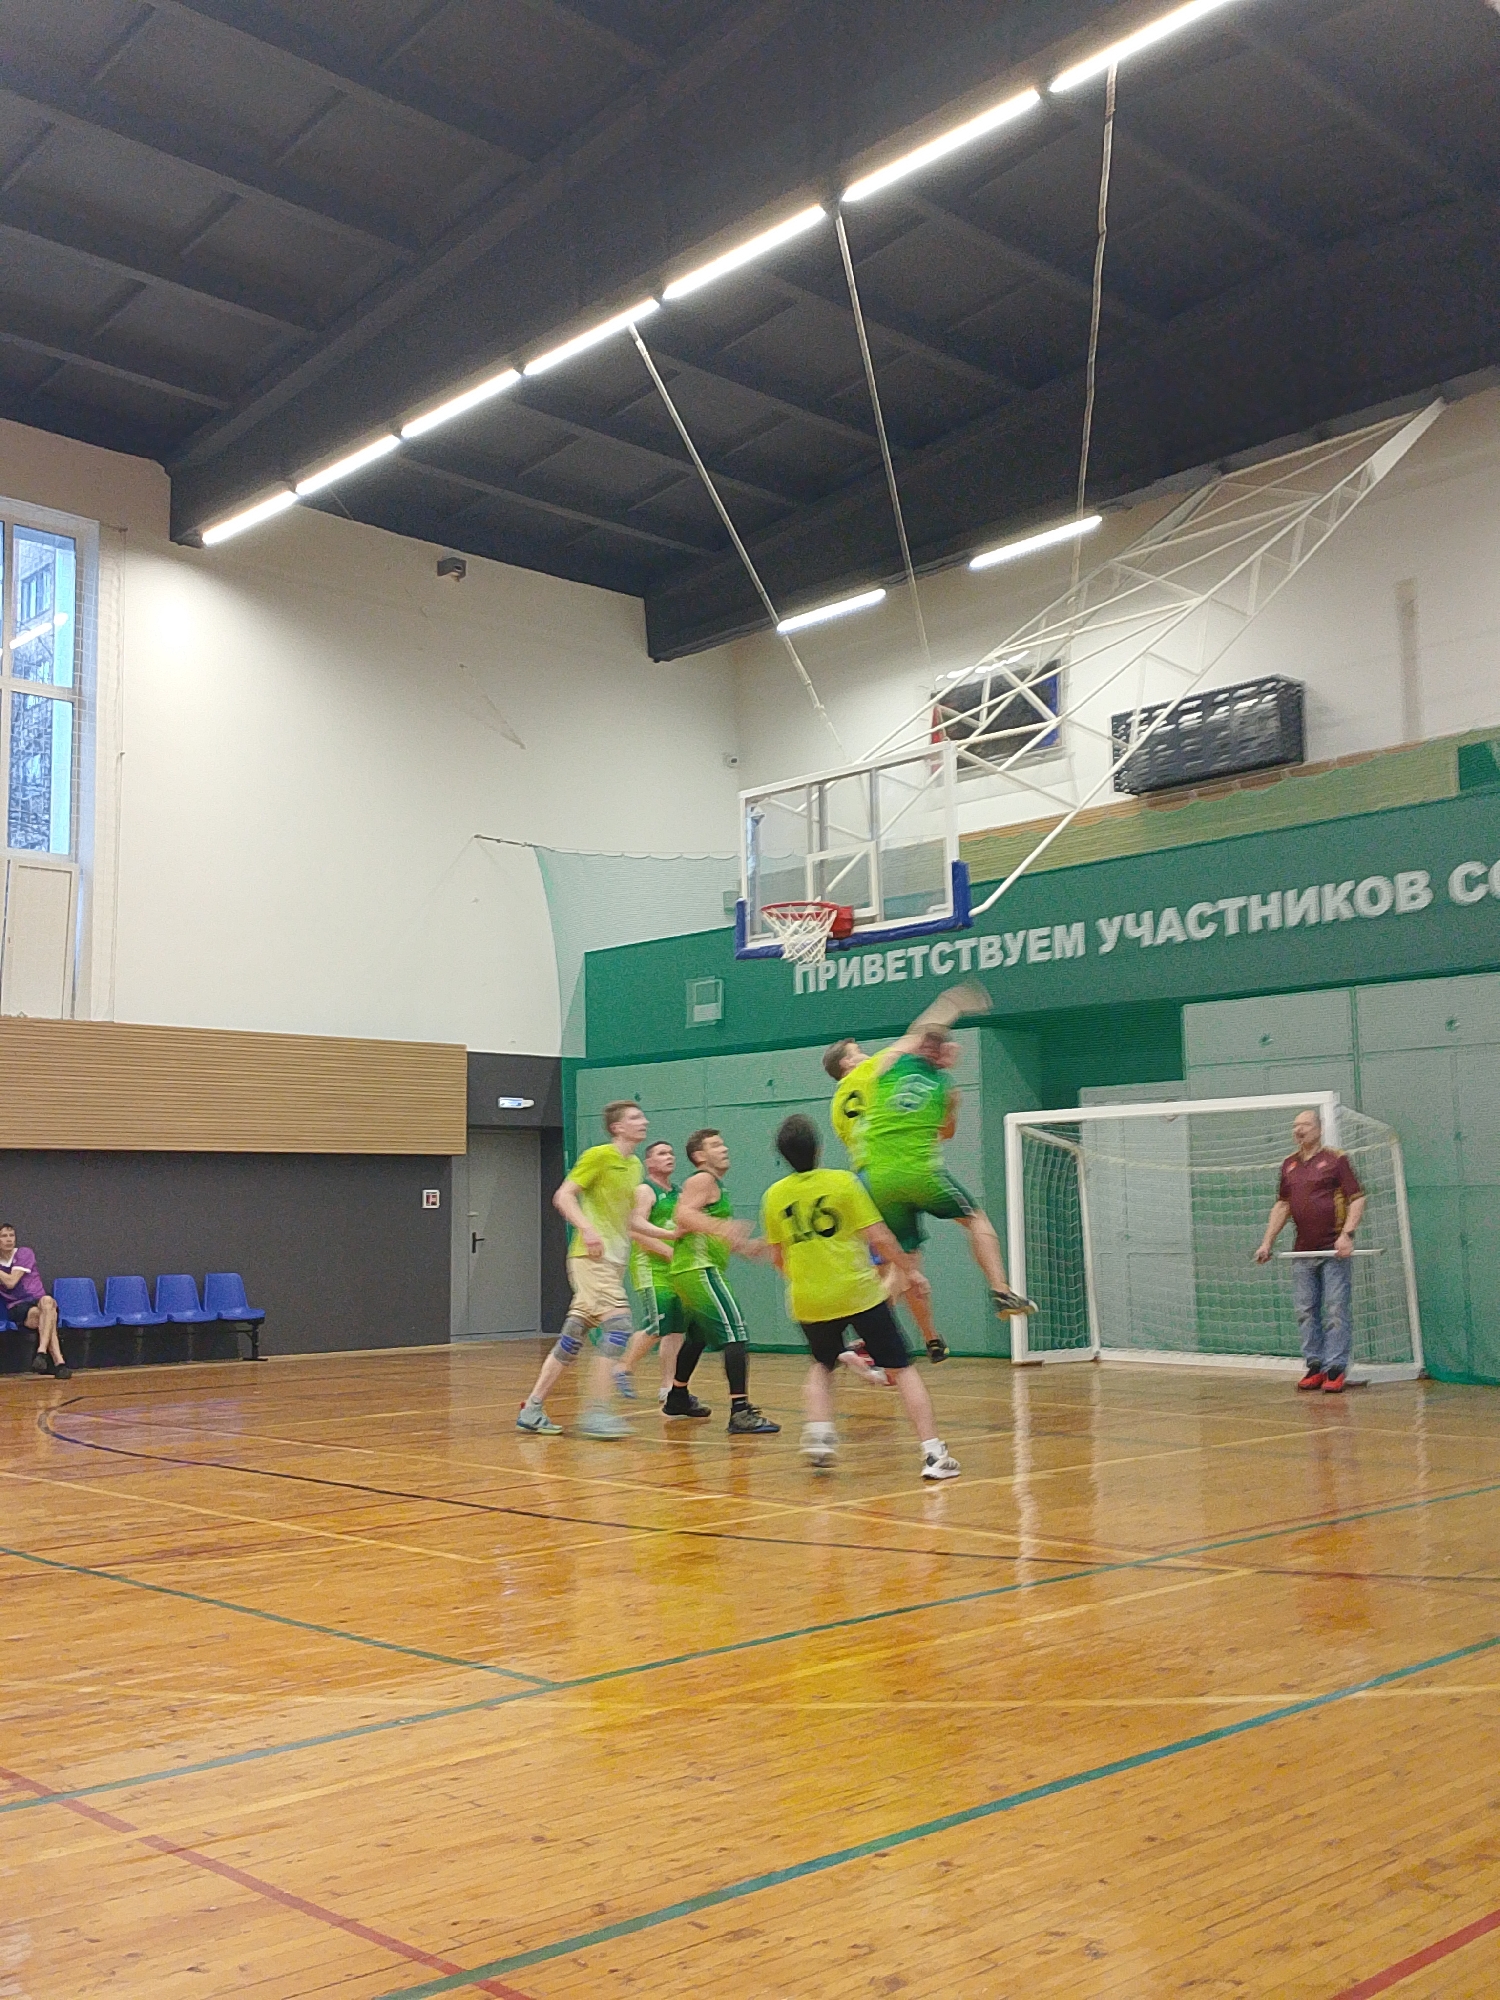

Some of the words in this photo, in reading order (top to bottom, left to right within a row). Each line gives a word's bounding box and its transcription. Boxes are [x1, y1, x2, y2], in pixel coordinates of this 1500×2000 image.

[793, 922, 1086, 995] ПРИВЕТСТВУЕМ
[1096, 870, 1435, 955] УЧАСТНИКОВ
[782, 1194, 842, 1244] 16
